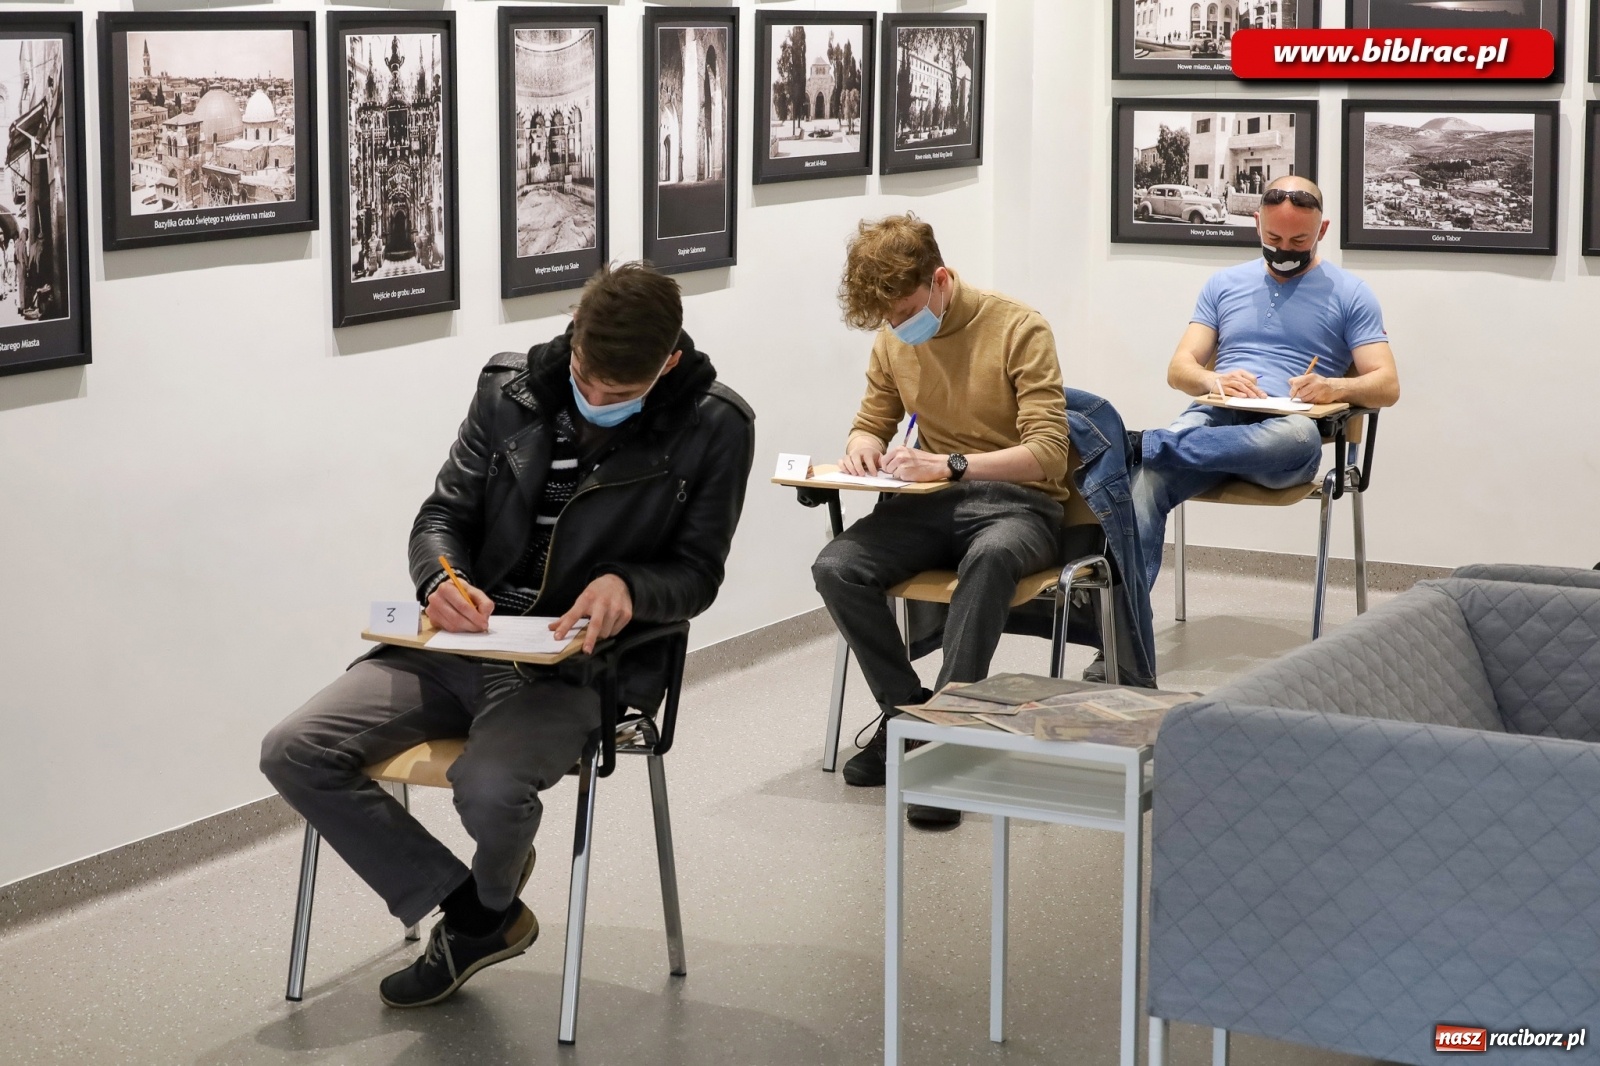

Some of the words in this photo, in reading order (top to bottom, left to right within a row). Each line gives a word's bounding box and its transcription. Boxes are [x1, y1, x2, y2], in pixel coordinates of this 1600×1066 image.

[1193, 63, 1213, 71] miasto,
[154, 217, 177, 231] Bazylika
[177, 216, 195, 227] Grobu
[195, 214, 220, 227] Świętego
[224, 211, 251, 222] widokiem
[250, 212, 259, 220] na
[258, 209, 276, 219] miasto
[1190, 229, 1206, 237] Nowy
[1431, 234, 1446, 242] Góra
[1446, 234, 1461, 242] Tabor
[390, 289, 397, 298] do
[396, 288, 411, 299] grobu
[410, 287, 426, 296] Jezusa
[21, 338, 40, 349] Miasta
[787, 459, 796, 471] 5
[386, 607, 397, 624] 3
